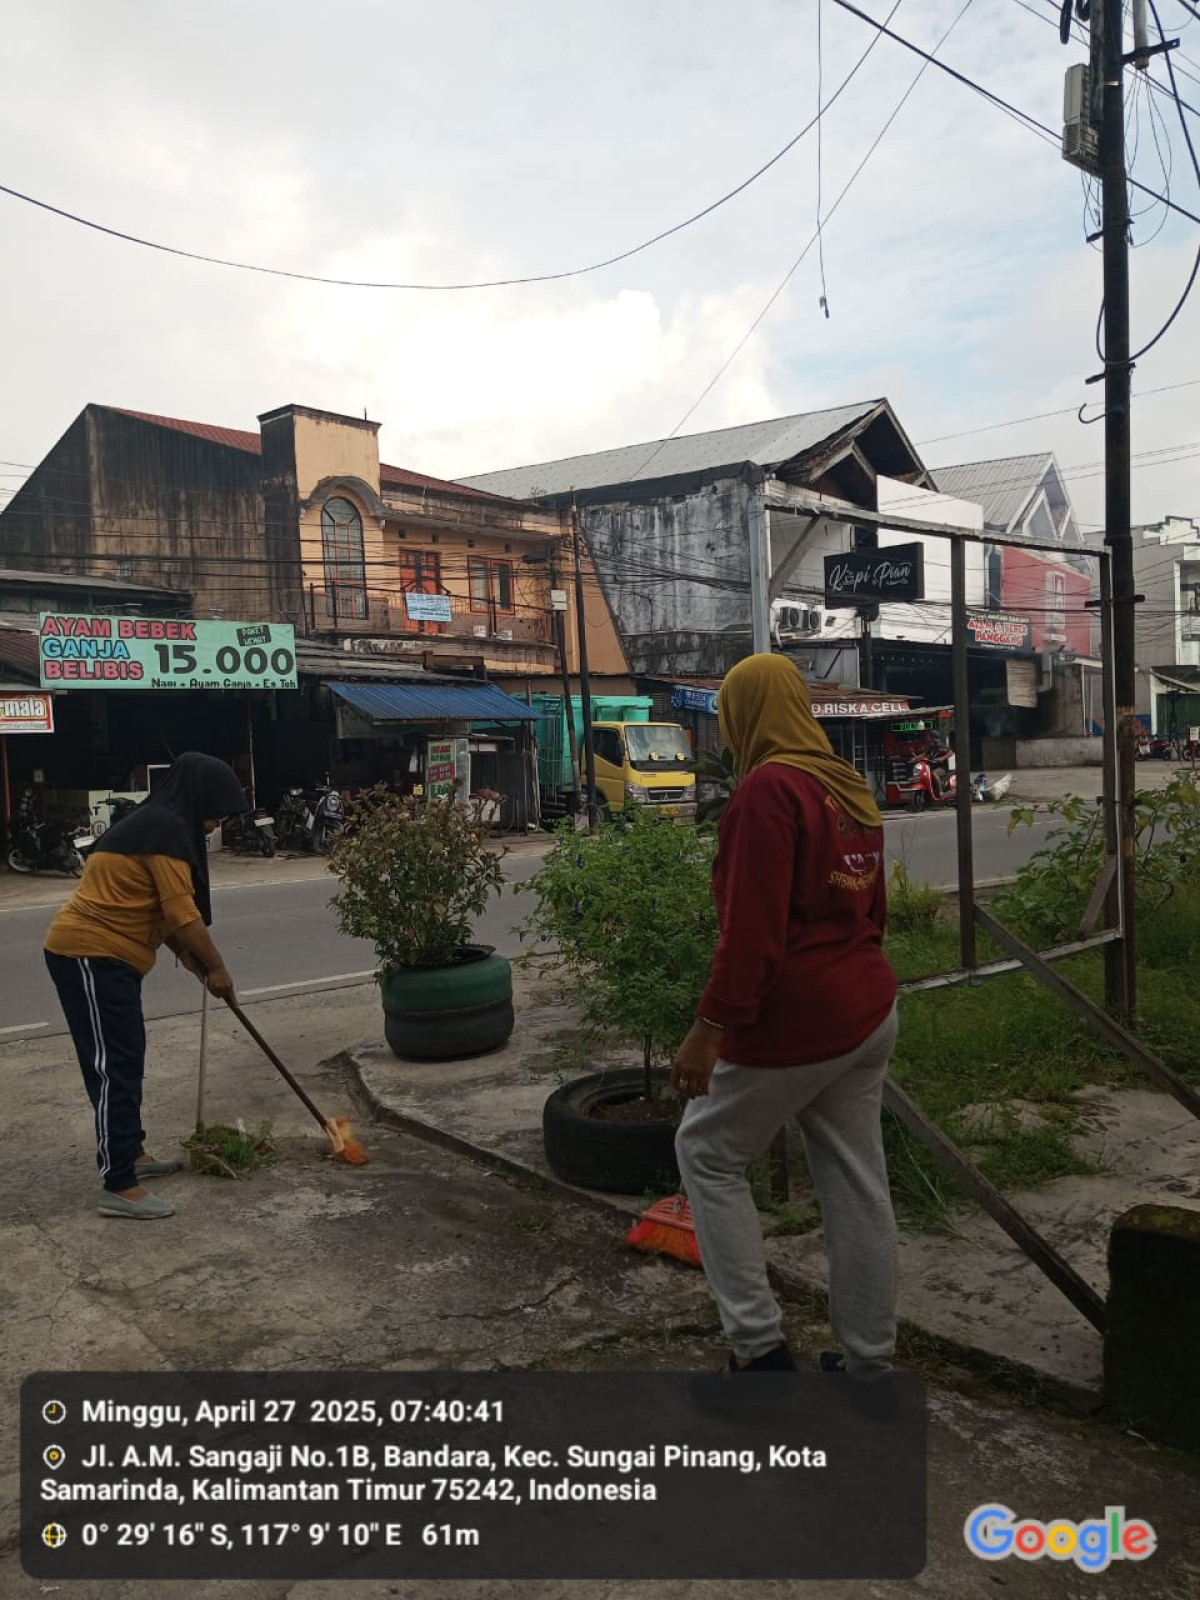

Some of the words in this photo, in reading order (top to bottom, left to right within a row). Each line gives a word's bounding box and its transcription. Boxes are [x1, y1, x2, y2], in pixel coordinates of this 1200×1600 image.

[40, 616, 111, 637] AYAM
[118, 619, 197, 640] BEBEK
[42, 638, 130, 659] GANJA
[154, 644, 294, 675] 15.000
[44, 660, 144, 680] BELIBIS
[190, 679, 219, 689] Ayam
[871, 702, 906, 712] CELL
